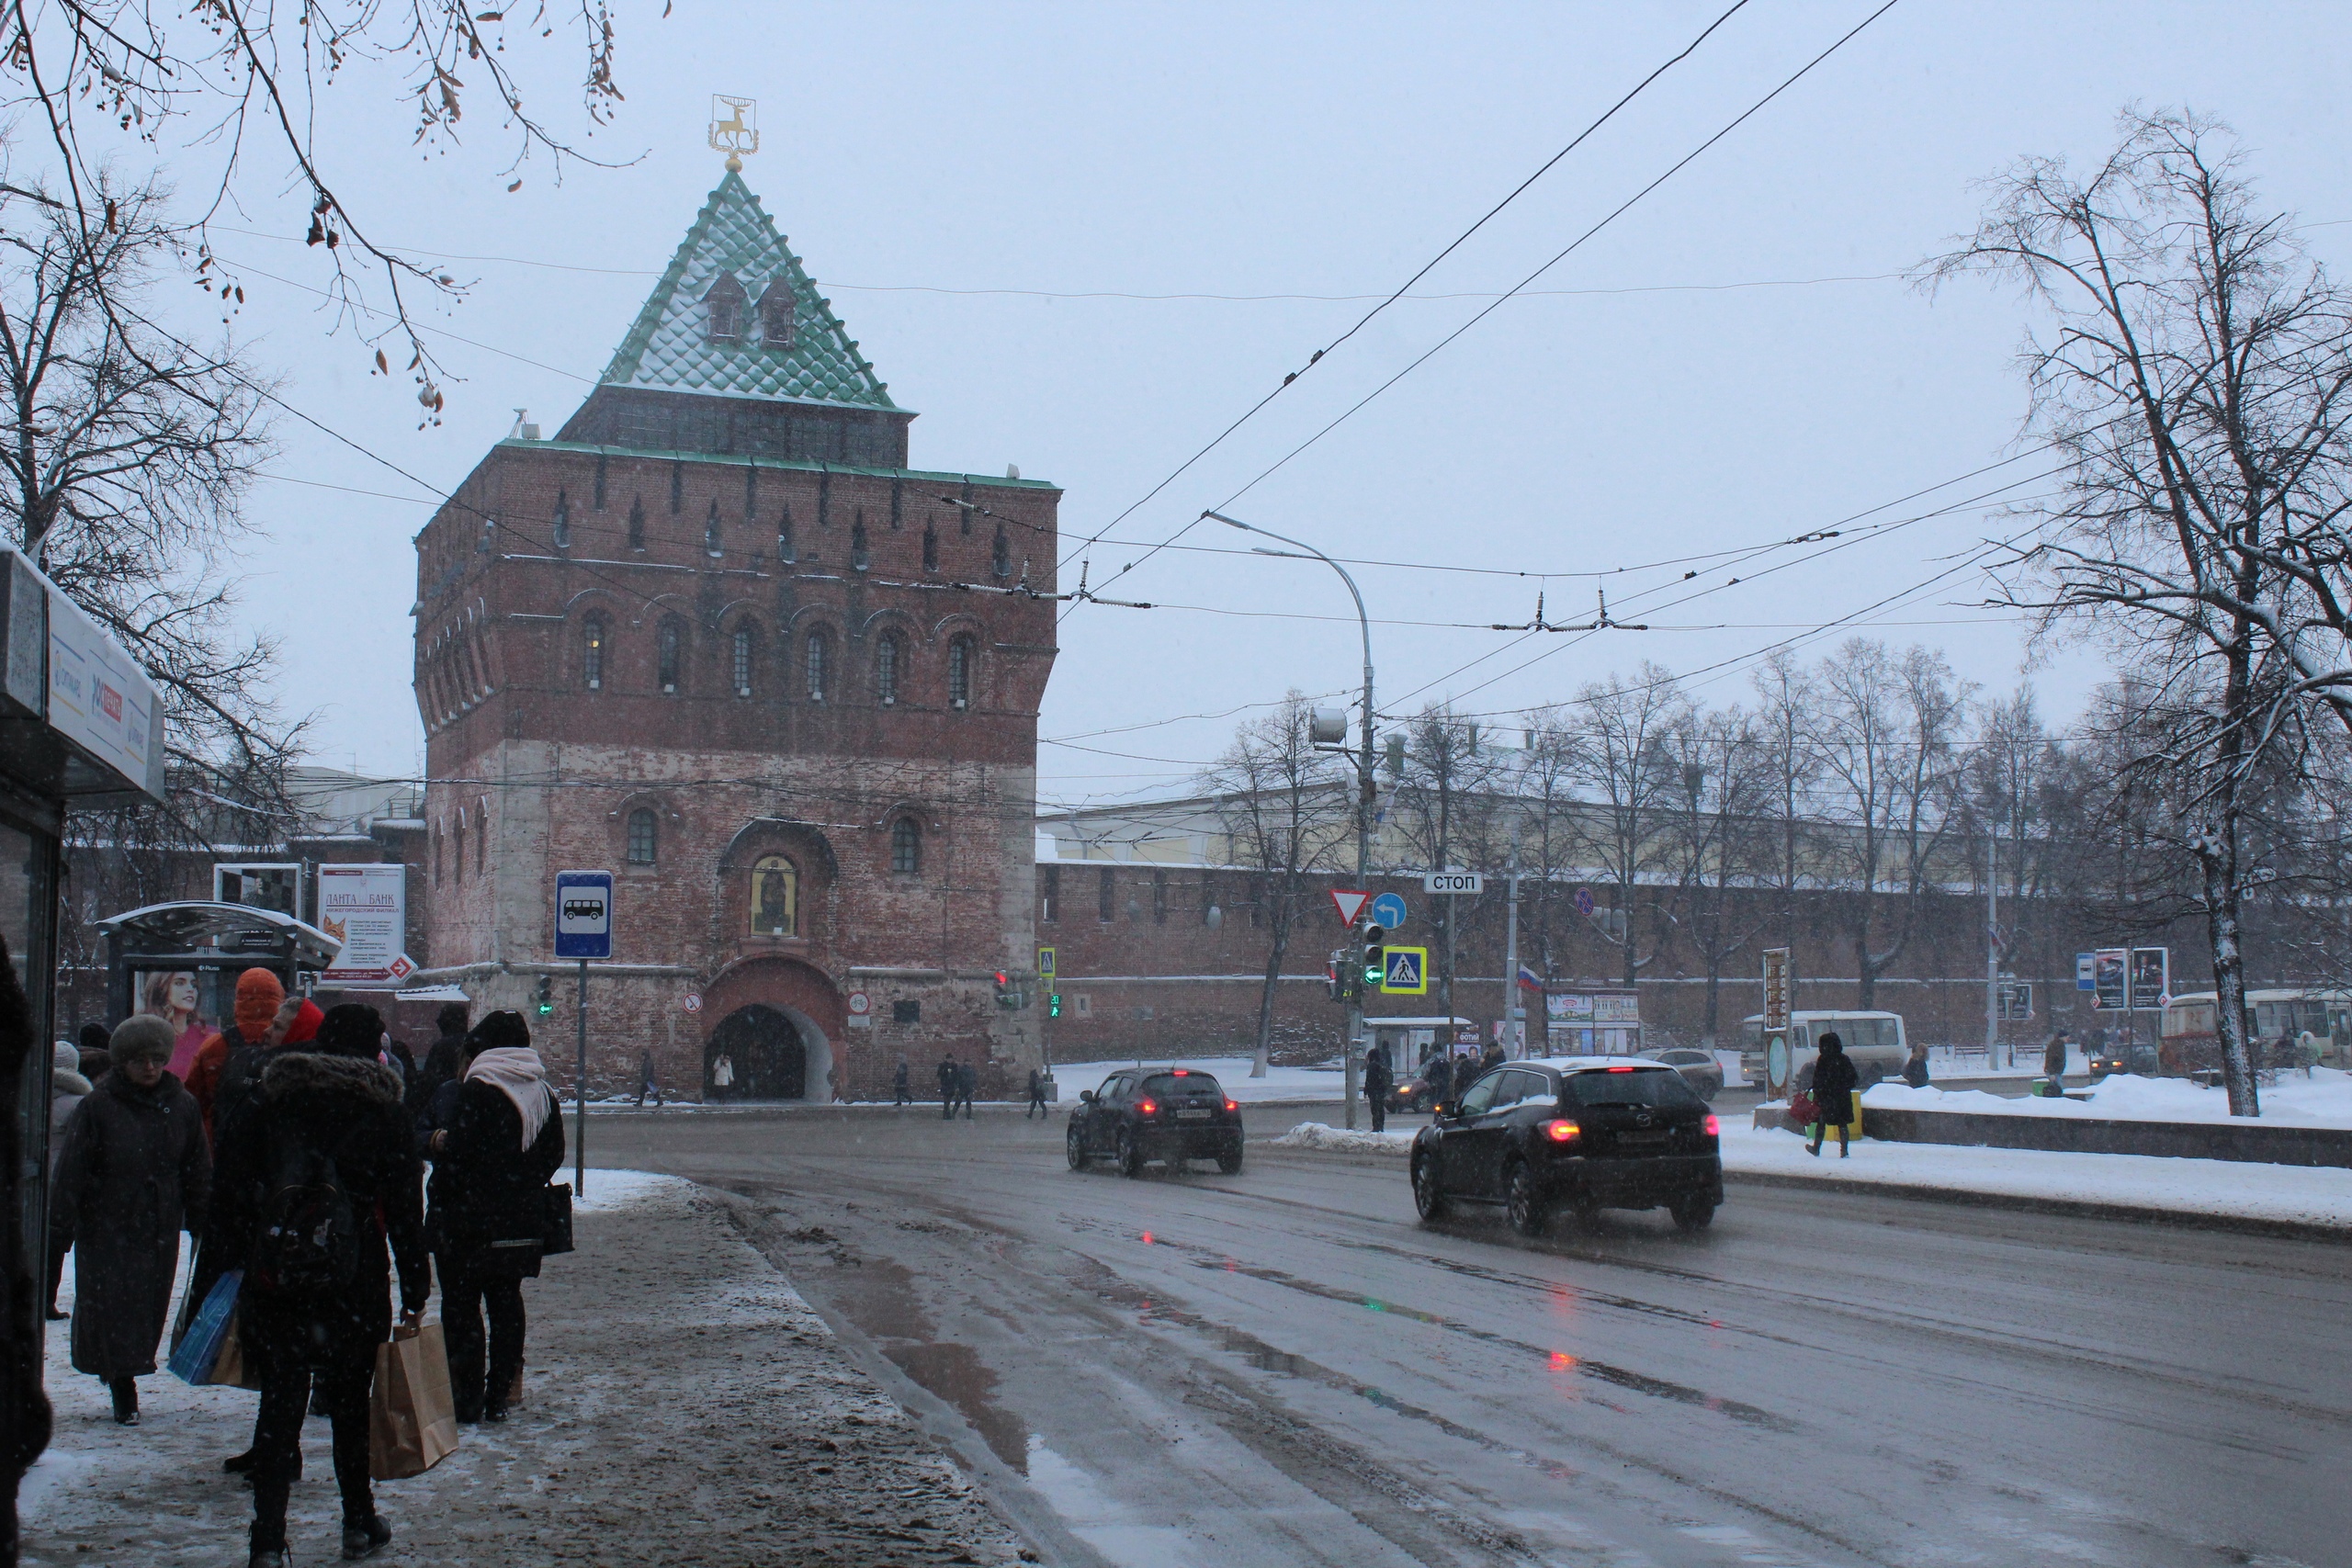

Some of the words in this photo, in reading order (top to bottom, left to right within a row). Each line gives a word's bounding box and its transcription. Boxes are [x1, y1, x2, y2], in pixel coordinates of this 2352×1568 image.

[1433, 875, 1475, 890] СТОП
[326, 894, 356, 905] ЛАНТА
[369, 894, 394, 905] БАНК
